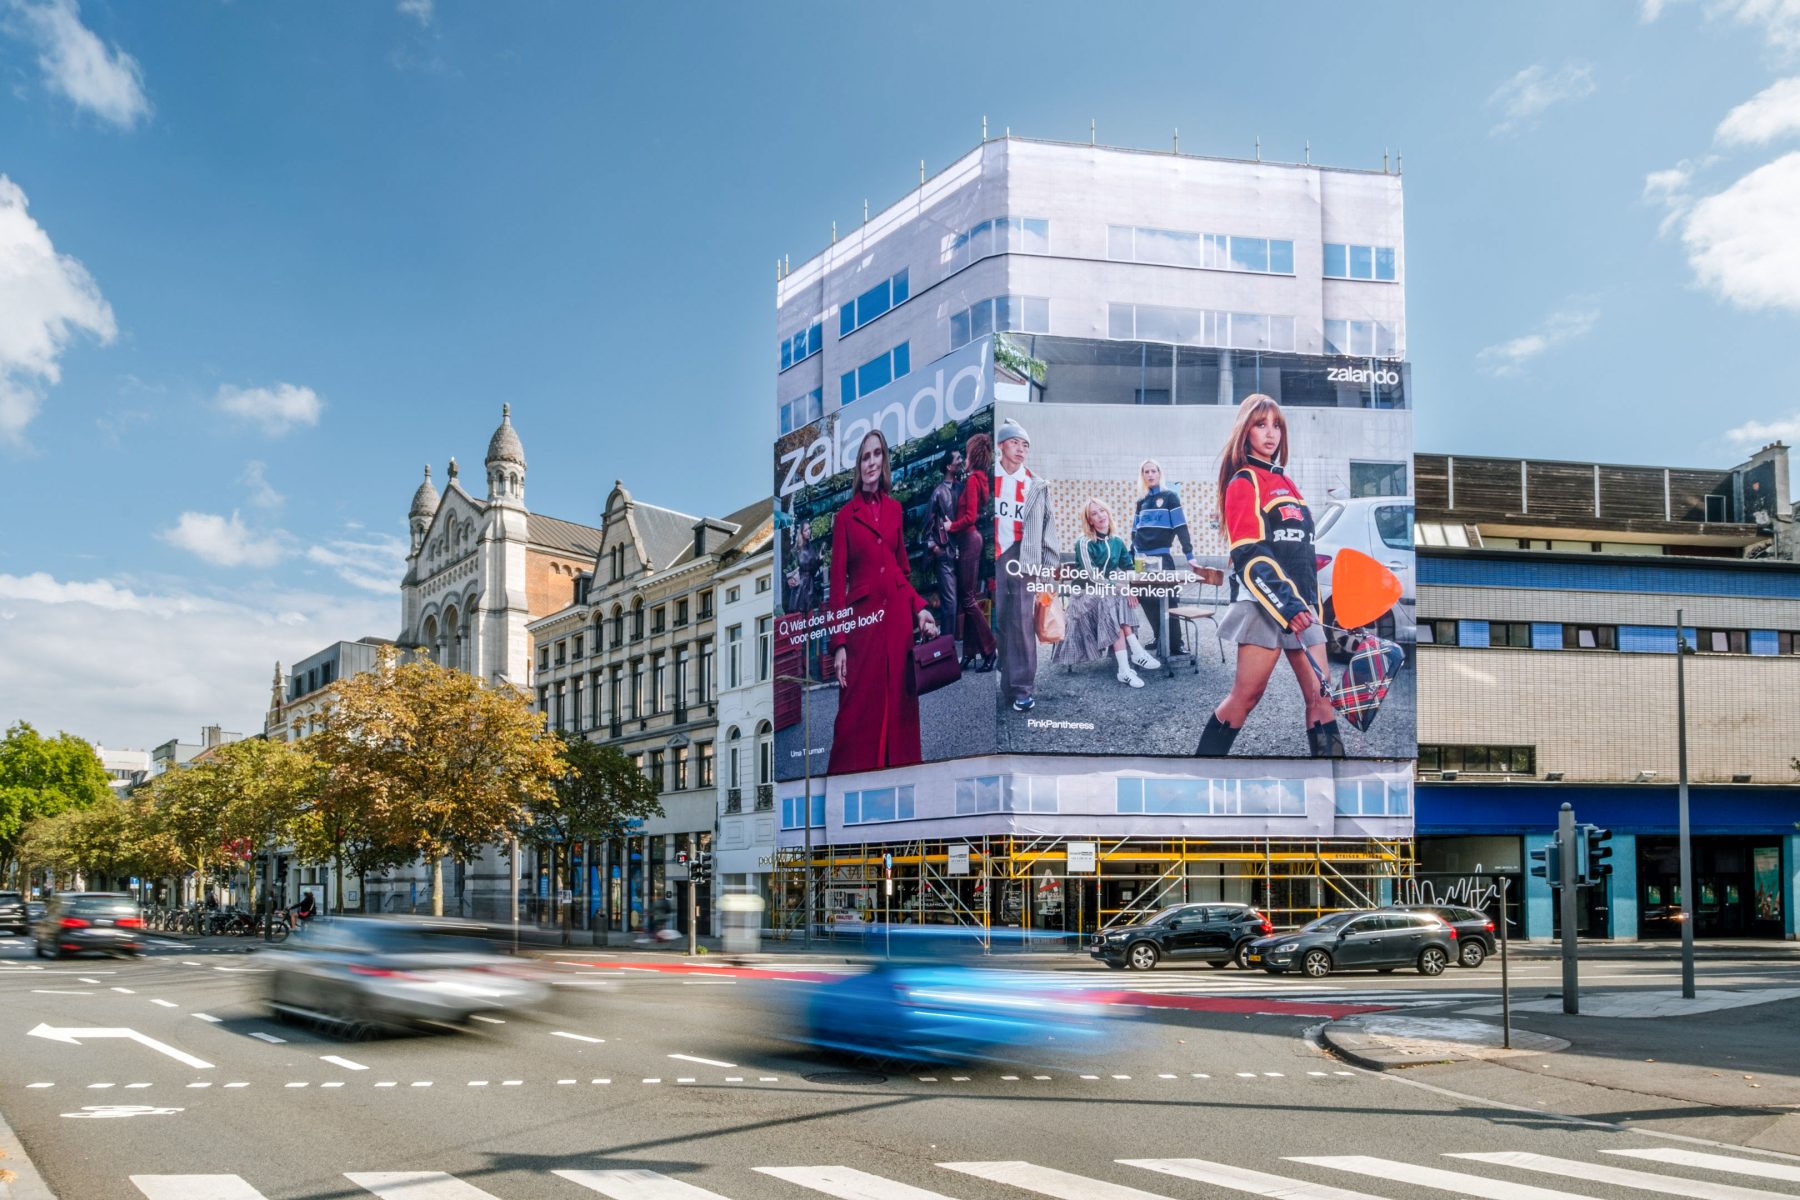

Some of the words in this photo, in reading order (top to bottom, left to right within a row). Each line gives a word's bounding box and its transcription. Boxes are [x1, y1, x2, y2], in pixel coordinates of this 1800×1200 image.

[1327, 366, 1399, 385] zalando
[780, 365, 986, 497] zalando
[1027, 563, 1056, 578] Wat
[1060, 566, 1089, 580] doe
[1092, 568, 1105, 580] ik
[1109, 570, 1136, 582] aan
[1140, 570, 1180, 583] zodat
[1183, 570, 1197, 585] je
[1026, 582, 1054, 593] aan
[1058, 583, 1081, 595] me
[1085, 582, 1117, 598] blijft
[1120, 584, 1183, 598] denken?
[789, 619, 807, 632] Wat
[808, 615, 825, 627] doe
[826, 610, 835, 621] ik
[836, 607, 854, 619] aan
[790, 633, 809, 645] voor
[810, 627, 827, 640] een
[828, 620, 856, 634] vurige
[858, 609, 885, 627] look?
[1027, 719, 1095, 730] PinkPantheress
